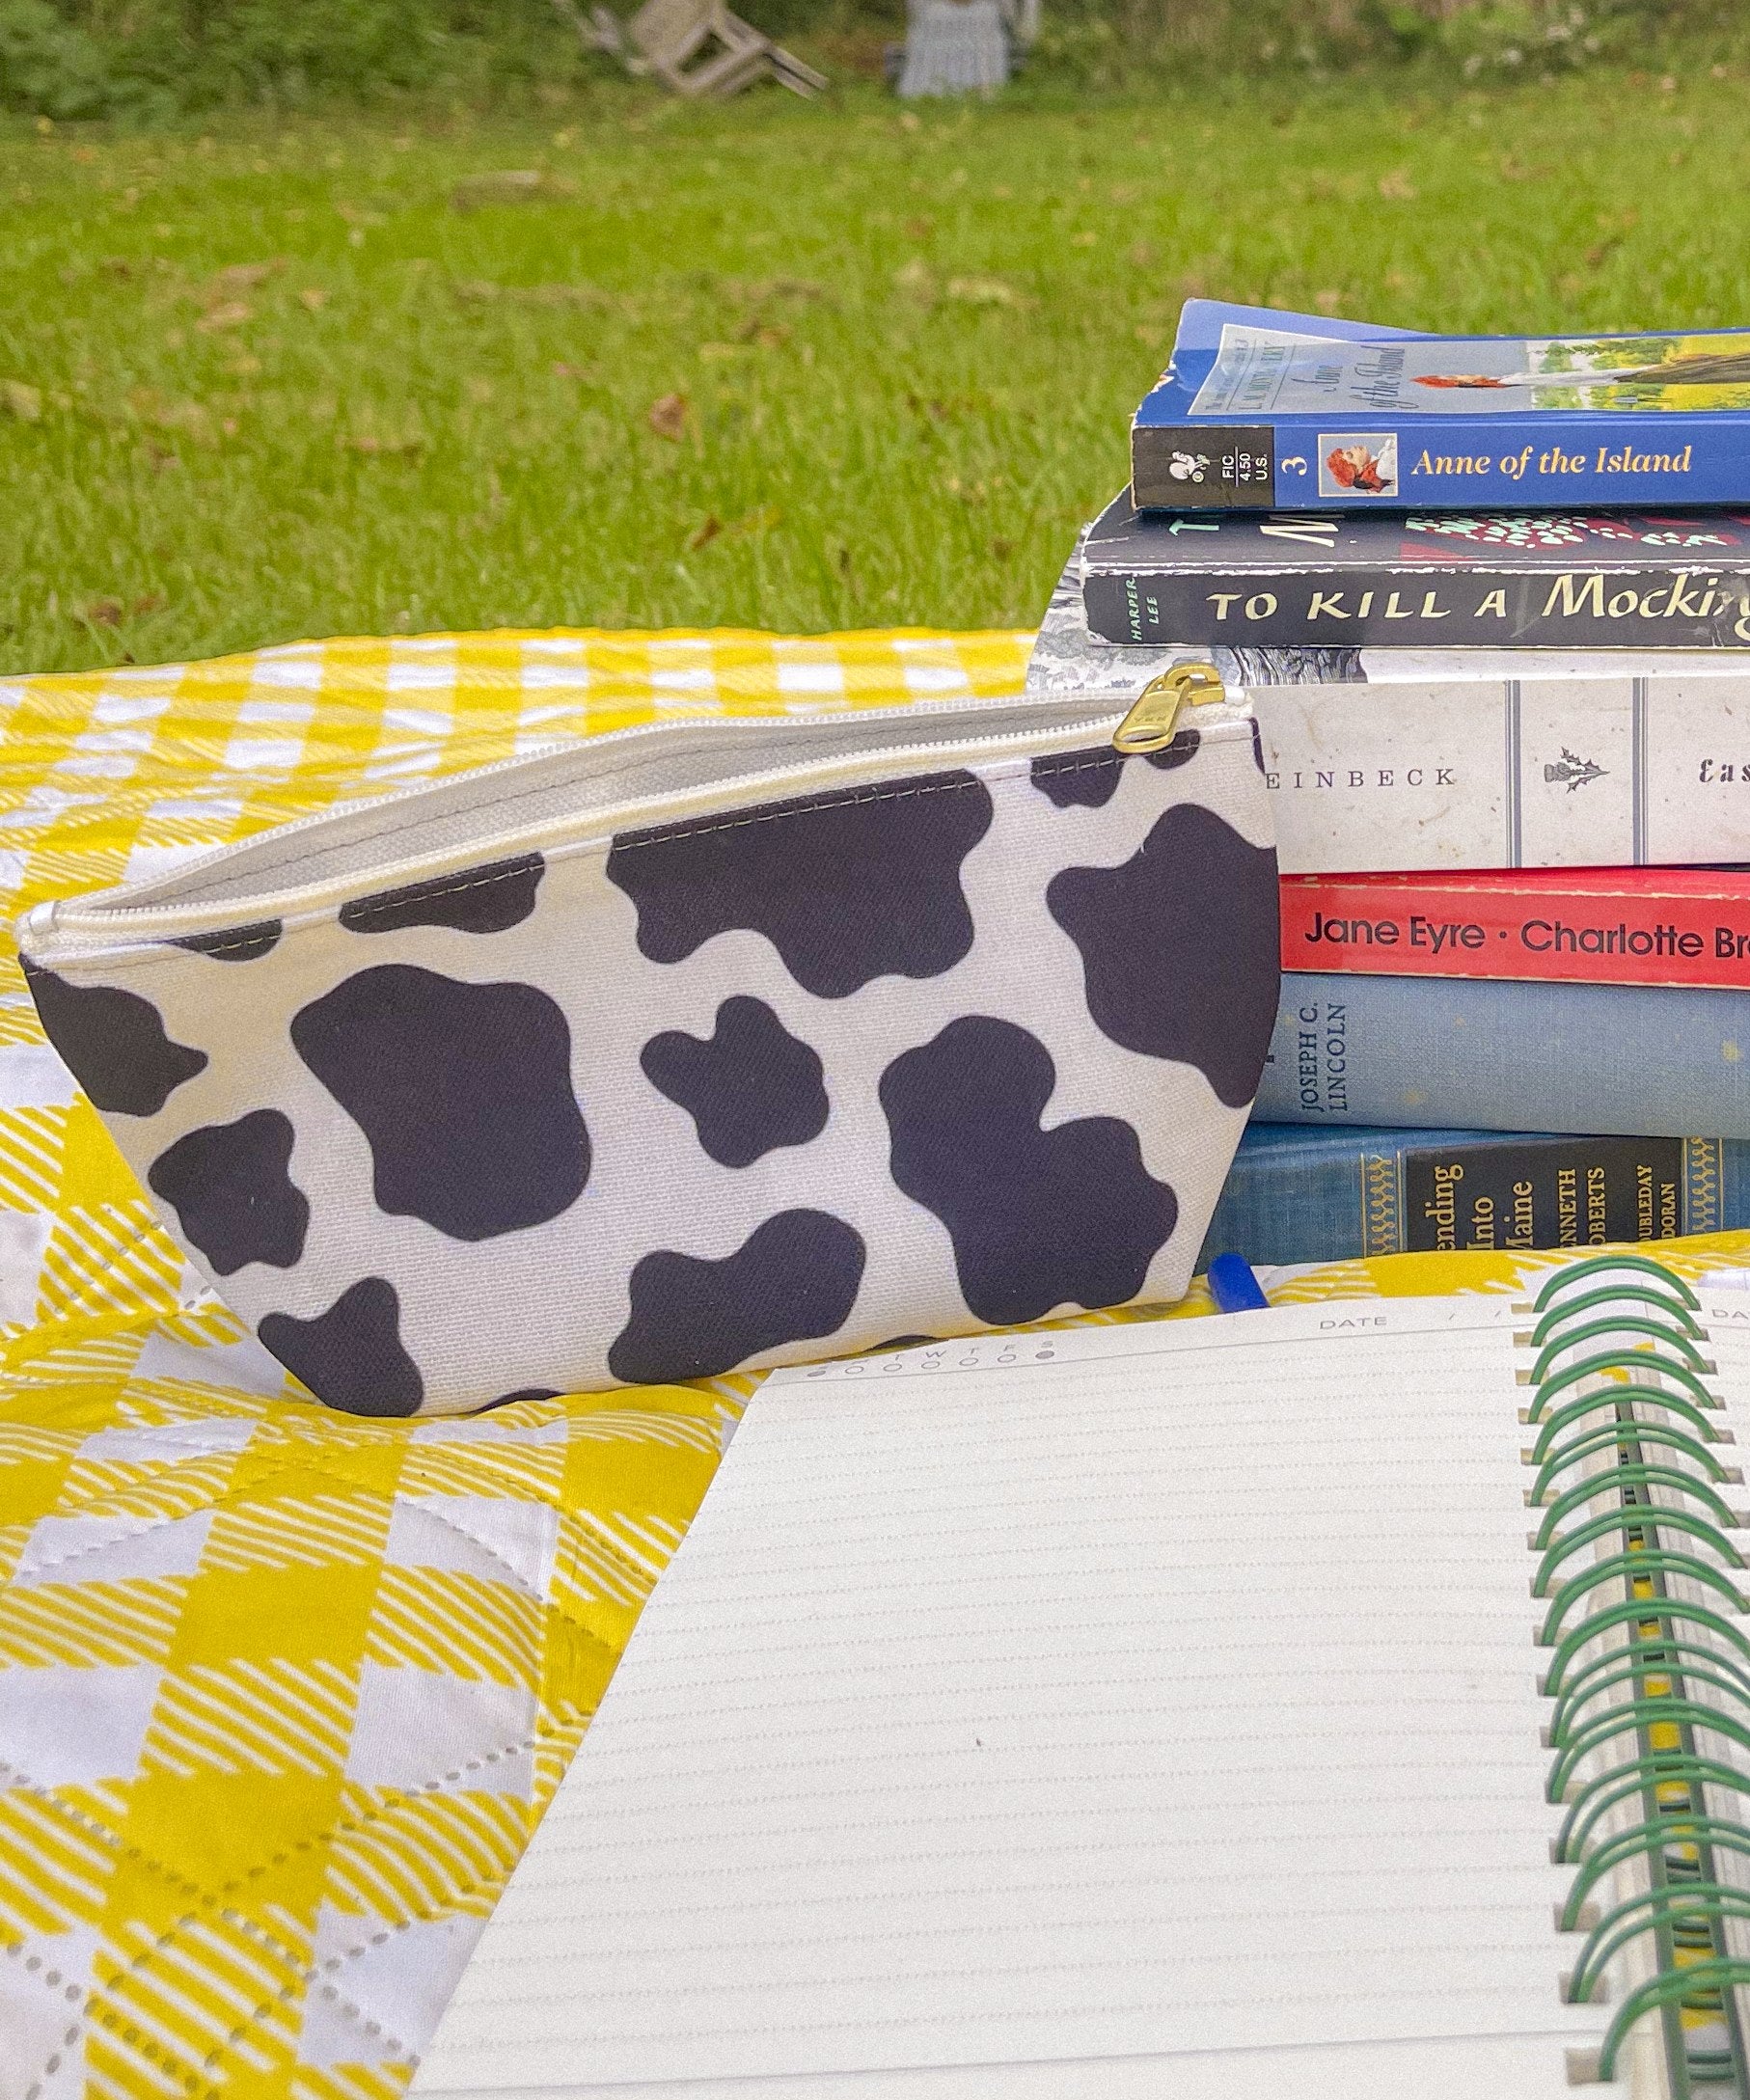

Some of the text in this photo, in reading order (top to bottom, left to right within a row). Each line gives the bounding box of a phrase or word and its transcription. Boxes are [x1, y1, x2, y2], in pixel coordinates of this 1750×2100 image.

[1221, 455, 1235, 478] FIC
[1239, 452, 1251, 482] 4.50
[1255, 453, 1269, 480] U.S.
[1281, 456, 1308, 477] 3
[1410, 445, 1693, 481] Anne of the Island
[1125, 577, 1142, 641] HARPER
[1146, 596, 1160, 625] LEE
[1206, 591, 1278, 621] TO
[1306, 590, 1452, 620] KILL
[1473, 589, 1507, 618] A
[1304, 912, 1400, 944] Jane
[1409, 916, 1487, 955] Eyre
[1520, 919, 1705, 957] Charlotte
[1299, 1002, 1325, 1113] JOSEPH C.
[1326, 1002, 1349, 1112] LINCOLN
[1660, 1183, 1677, 1240] DORAN
[1319, 1316, 1387, 1330] DATE
[1711, 1308, 1750, 1321] DA
